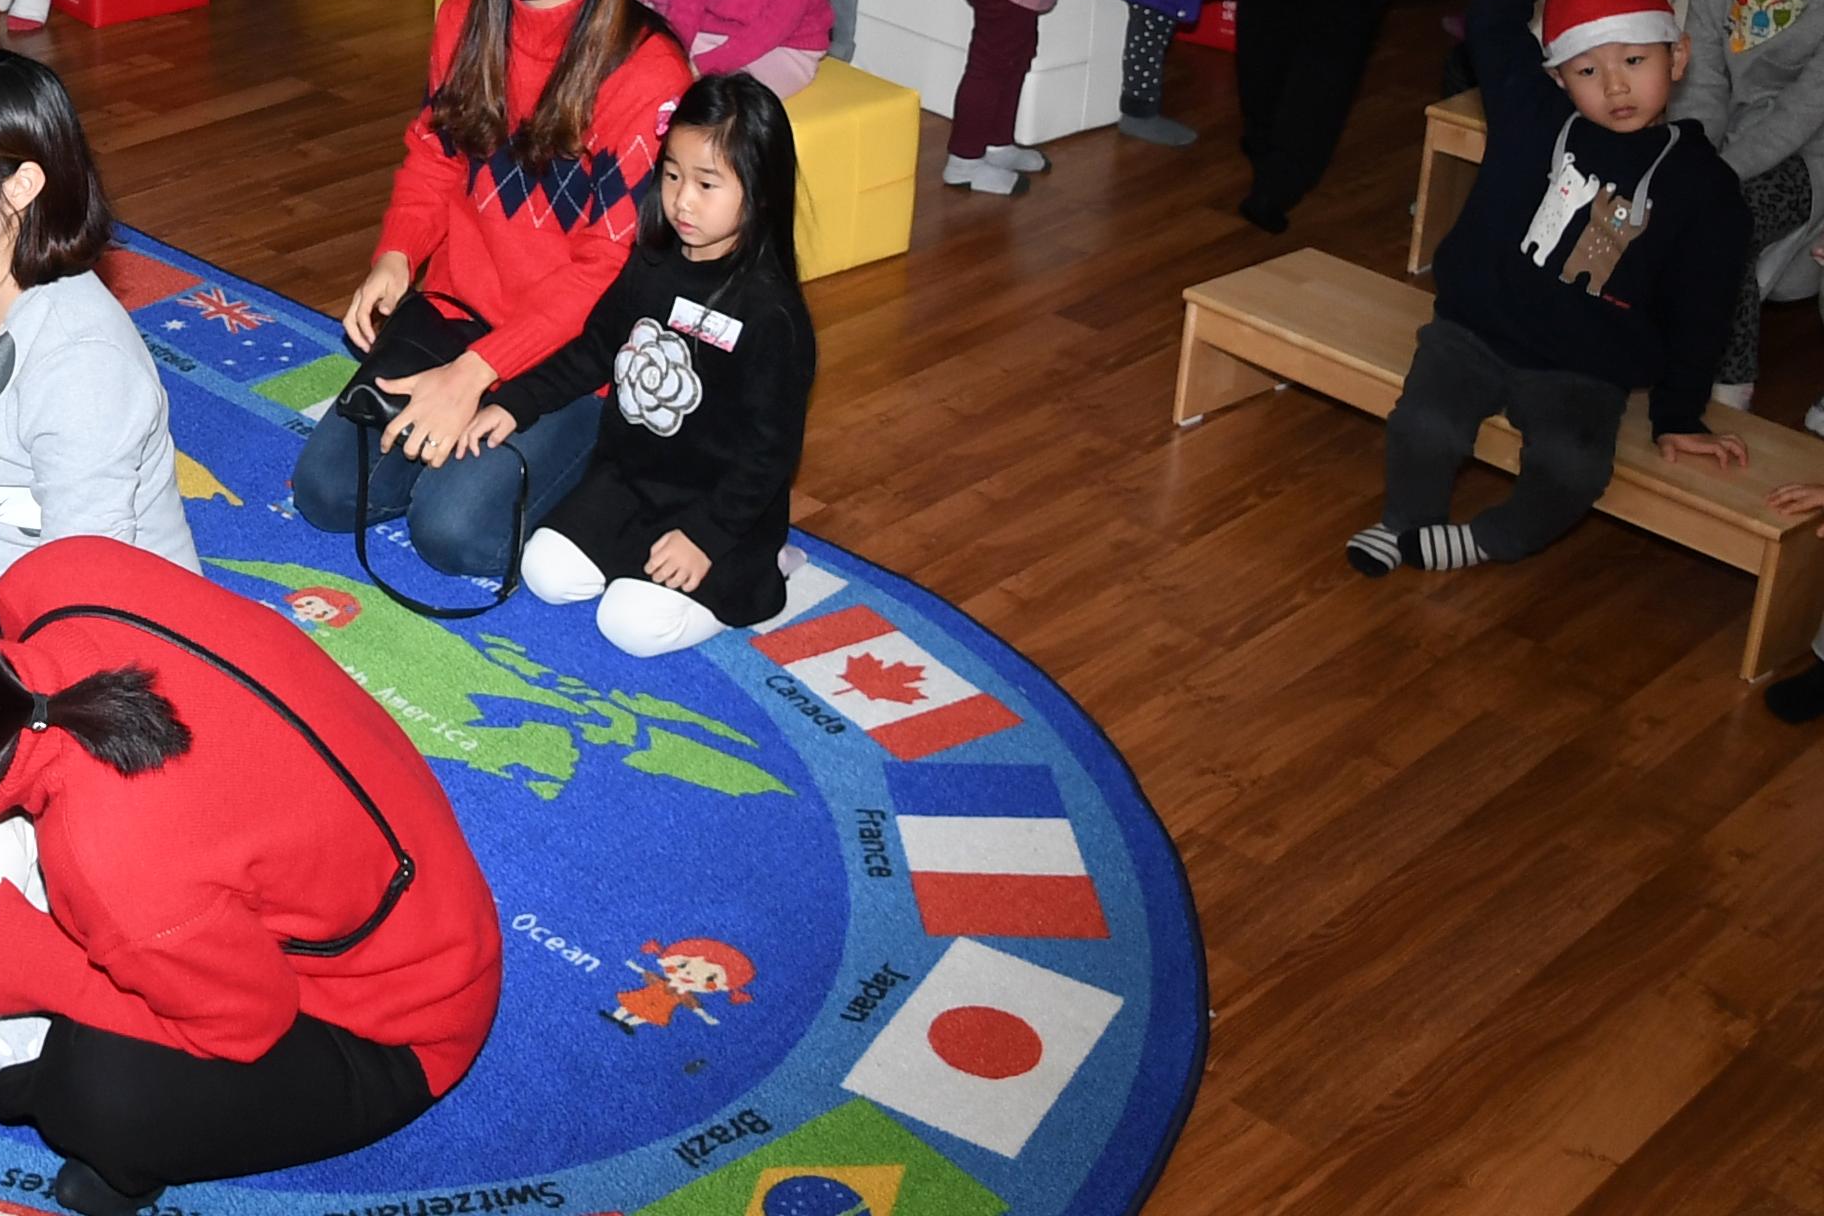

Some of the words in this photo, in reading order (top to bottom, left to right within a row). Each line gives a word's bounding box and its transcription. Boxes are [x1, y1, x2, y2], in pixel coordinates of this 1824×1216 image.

[283, 418, 315, 436] Ita
[375, 686, 478, 751] America
[765, 674, 847, 734] Canada
[854, 808, 892, 878] France
[512, 913, 601, 973] Ocean
[840, 962, 910, 1022] Japan
[673, 1109, 773, 1169] Brazil
